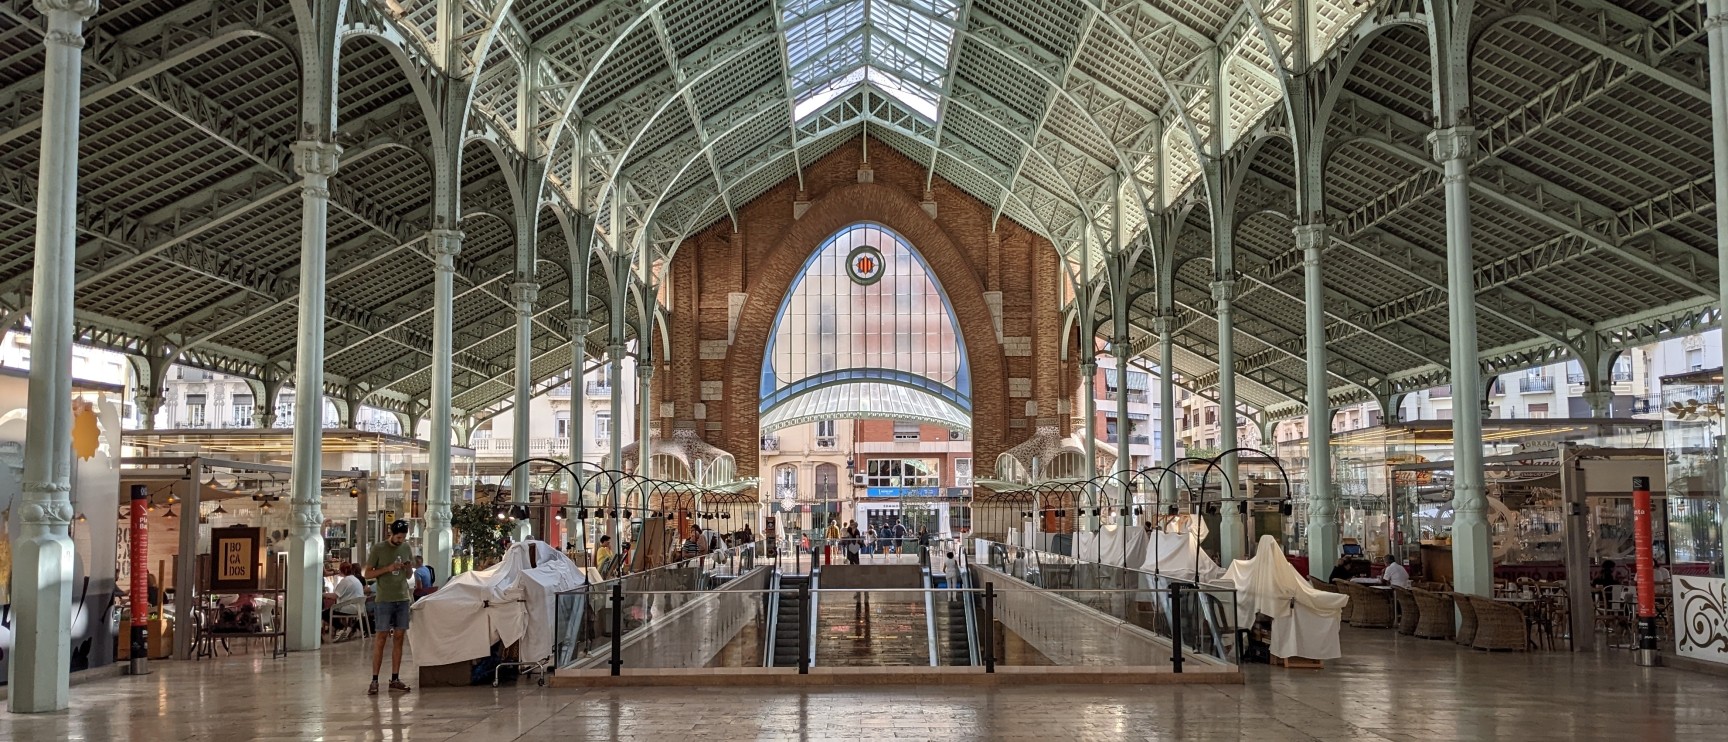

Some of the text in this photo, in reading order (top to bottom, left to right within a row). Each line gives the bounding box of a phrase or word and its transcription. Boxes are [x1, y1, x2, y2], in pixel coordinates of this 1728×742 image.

[230, 542, 241, 552] BO
[230, 554, 240, 564] CA
[230, 566, 245, 576] DOS
